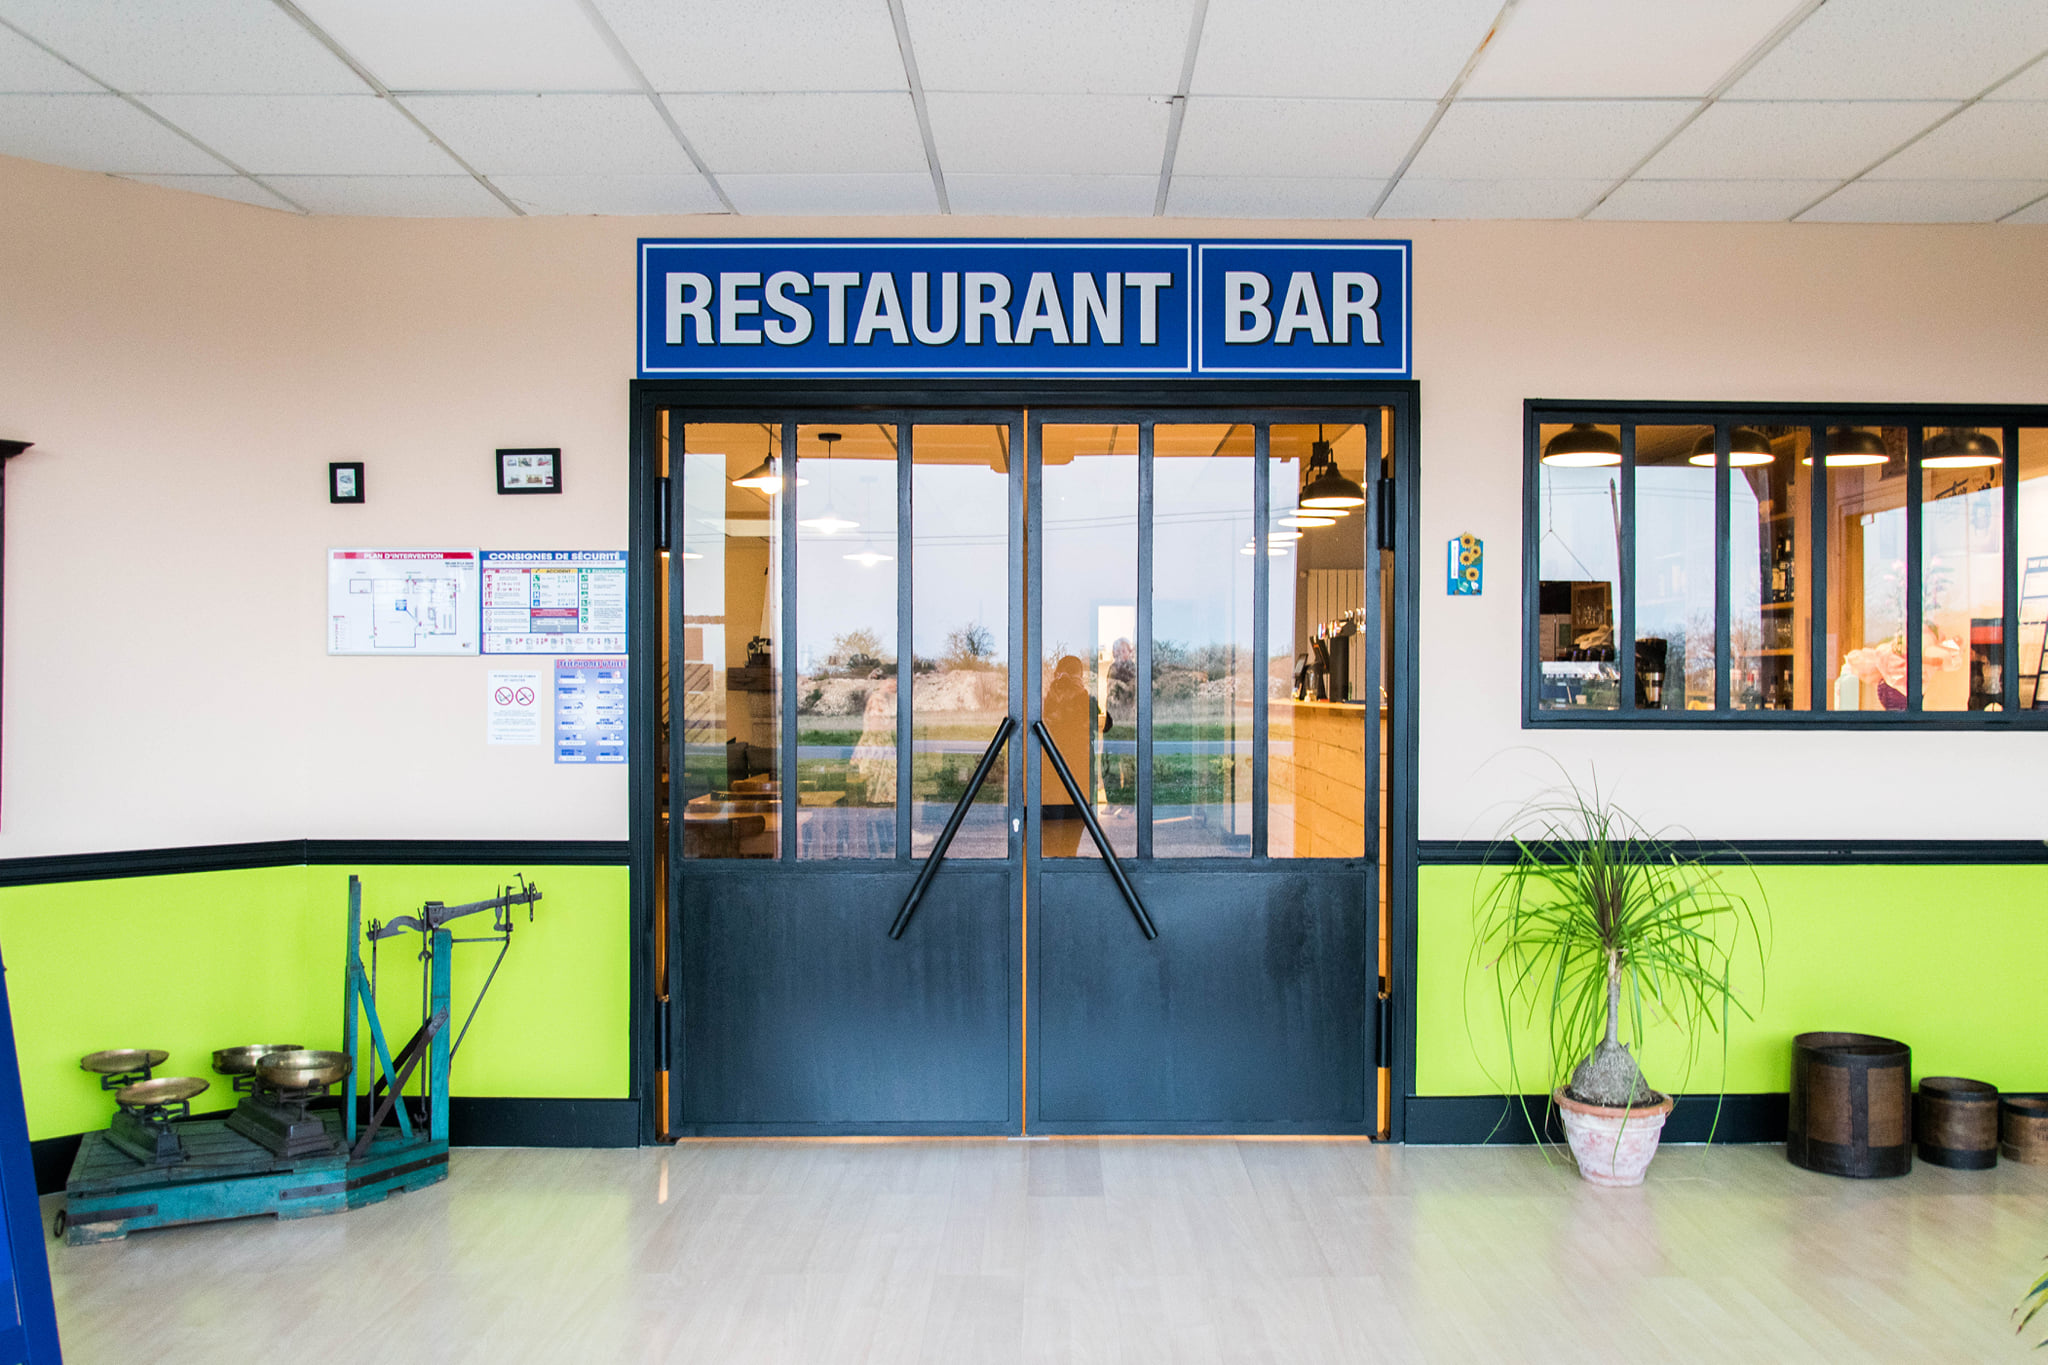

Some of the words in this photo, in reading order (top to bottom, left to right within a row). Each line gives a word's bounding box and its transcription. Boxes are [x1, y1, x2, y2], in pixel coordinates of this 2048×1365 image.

[666, 271, 1174, 346] RESTAURANT
[1225, 271, 1383, 346] BAR
[489, 552, 552, 560] CONSIGNES
[555, 552, 569, 560] DE
[571, 551, 620, 560] SÉCURITÉ
